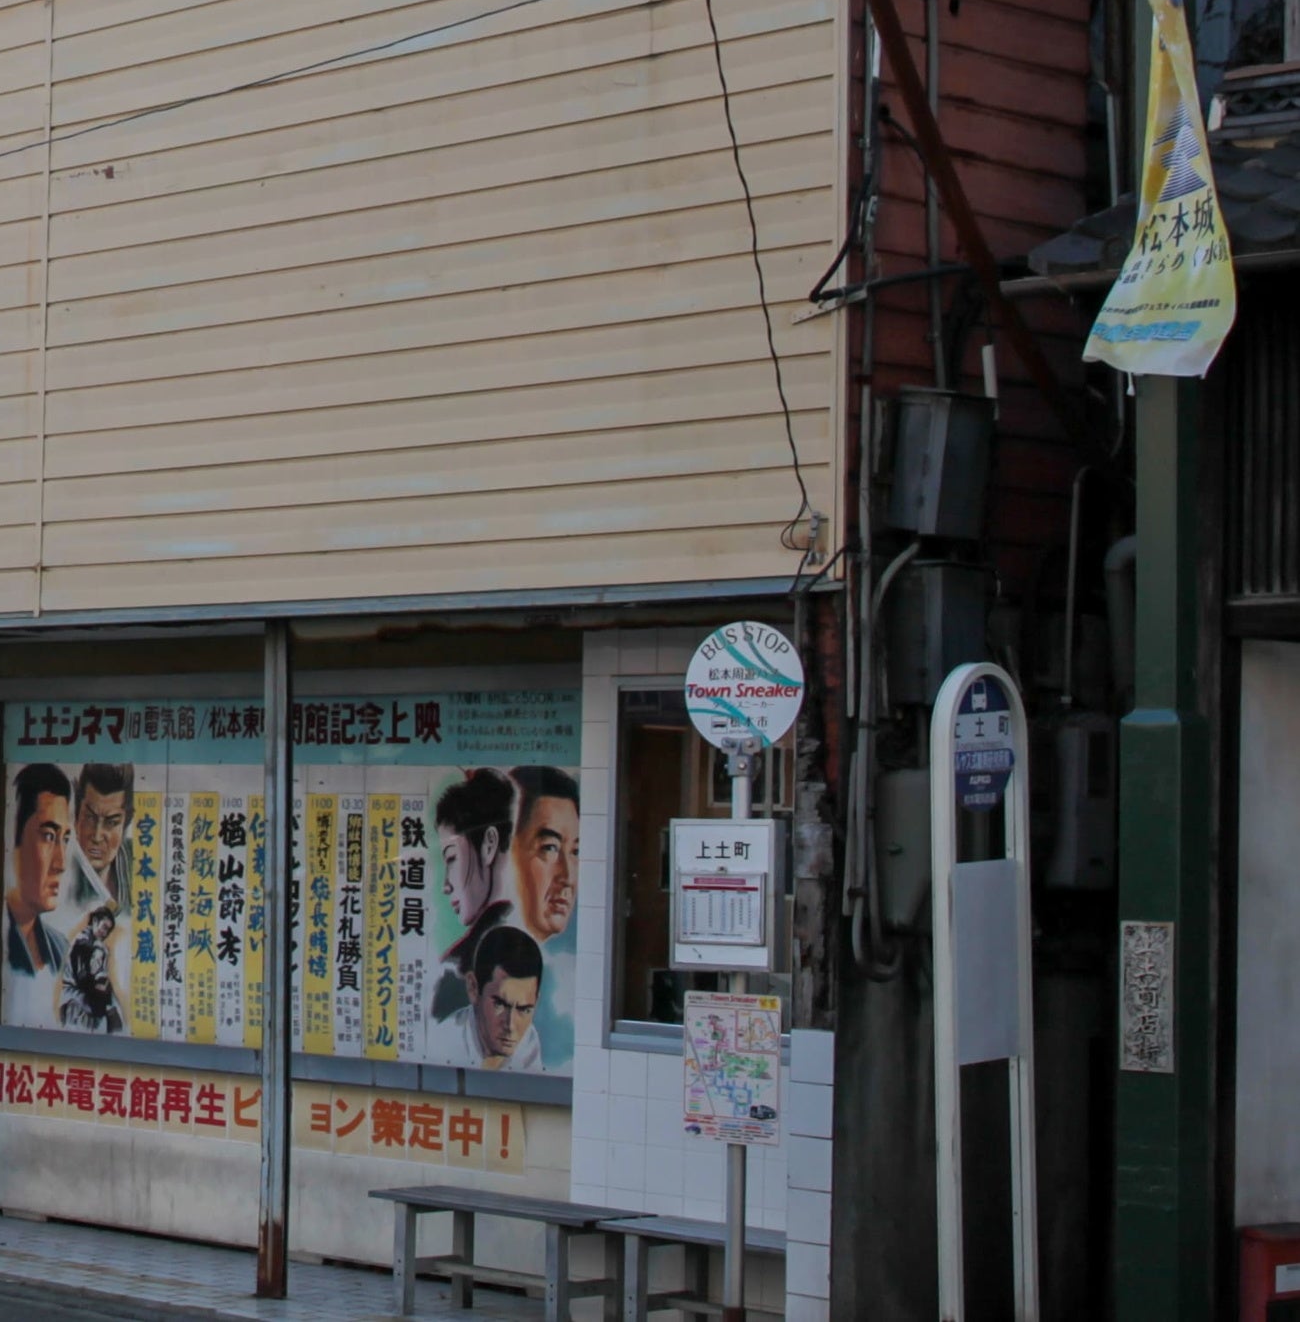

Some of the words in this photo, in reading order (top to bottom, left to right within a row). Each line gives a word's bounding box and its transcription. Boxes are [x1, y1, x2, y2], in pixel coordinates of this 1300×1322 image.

[687, 683, 732, 699] Town
[735, 683, 801, 698] Sneaker
[700, 628, 738, 661] BUS
[743, 625, 790, 656] STOP
[135, 813, 157, 964] 宮本武蔵
[218, 812, 248, 967] 楢山節考
[400, 816, 429, 936] 鉄道員
[696, 840, 751, 860] 上土町
[336, 885, 363, 992] 花札勝負
